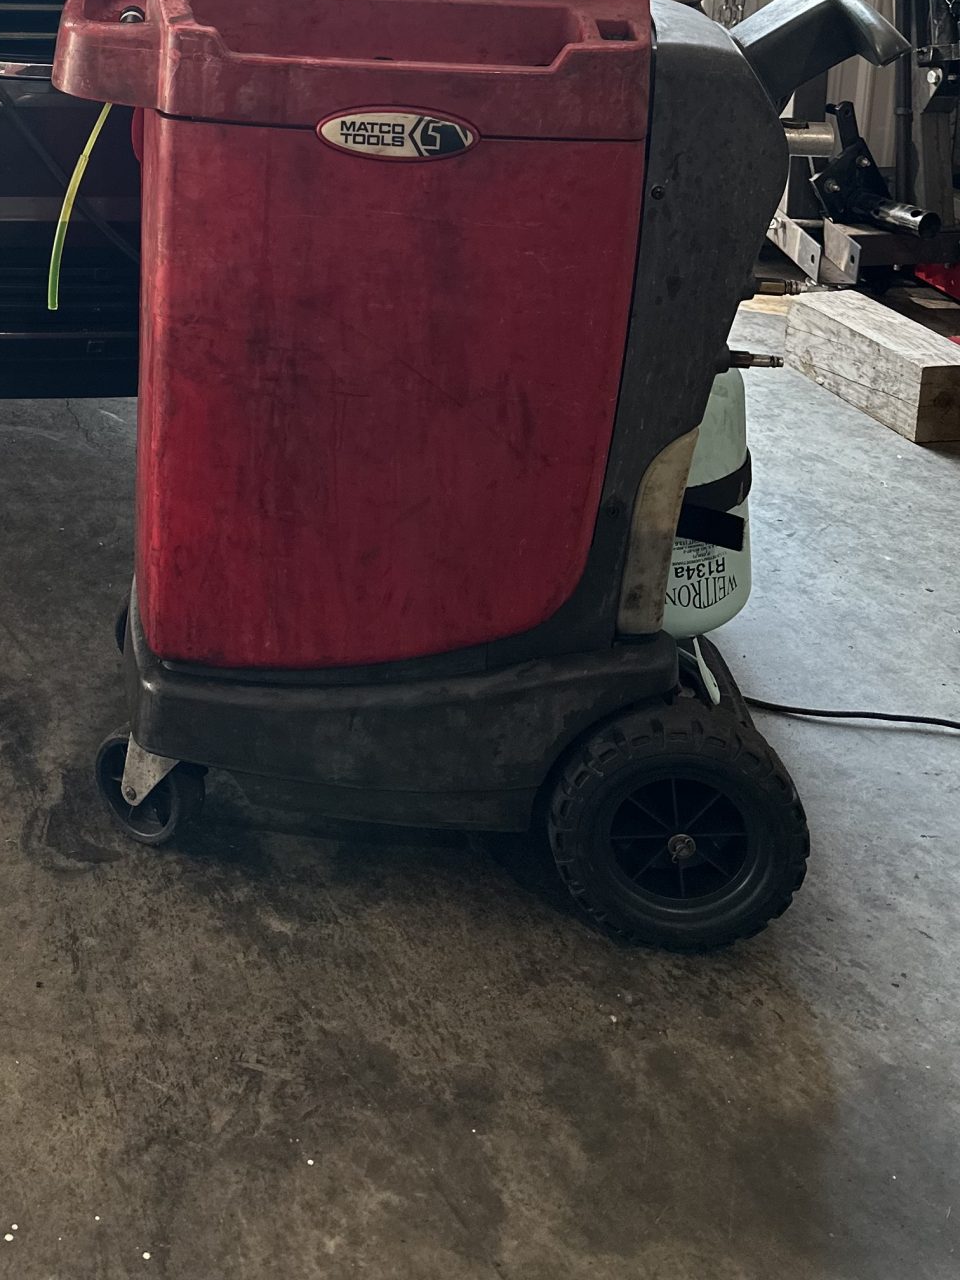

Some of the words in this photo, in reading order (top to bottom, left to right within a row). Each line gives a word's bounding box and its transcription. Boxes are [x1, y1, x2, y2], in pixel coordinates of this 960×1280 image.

[340, 120, 405, 135] MATCO
[340, 133, 405, 147] TOOLS
[674, 557, 726, 581] R134a
[664, 573, 738, 610] WEITRON
